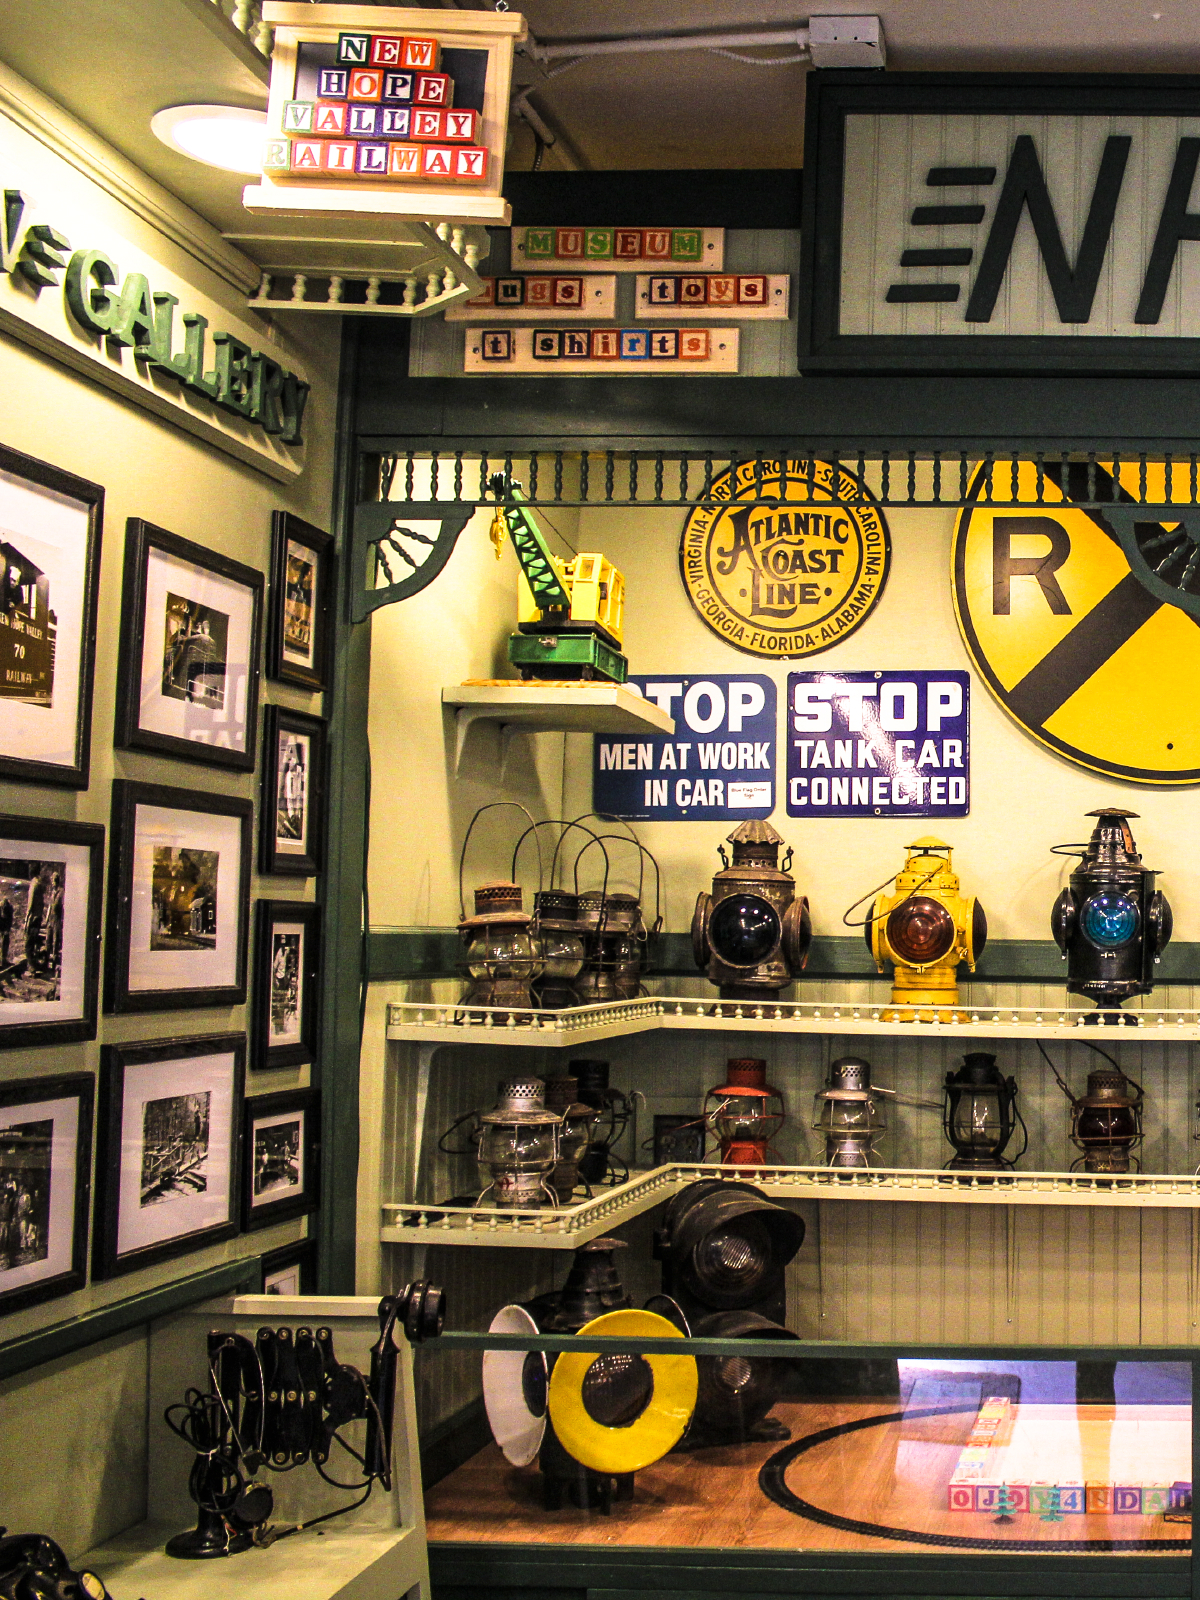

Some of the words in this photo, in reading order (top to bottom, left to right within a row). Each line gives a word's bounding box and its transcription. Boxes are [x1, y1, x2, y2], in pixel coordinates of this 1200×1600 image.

[341, 37, 433, 66] NEW
[323, 71, 445, 101] HOPE
[286, 105, 471, 137] VALLEY
[264, 143, 482, 175] RAILWAY
[529, 231, 700, 257] MUSEUM
[477, 281, 576, 302] ugs
[657, 278, 759, 301] toys
[65, 249, 310, 446] GALLERY
[540, 332, 702, 356] shirts
[687, 518, 710, 585] VIRGINIA
[716, 500, 850, 577] ATLANTIC
[758, 537, 845, 581] COAST
[993, 516, 1073, 615] R
[747, 567, 823, 619] LINE
[695, 588, 744, 642] GEORGIA
[820, 582, 876, 642] ALABAMA
[14, 643, 26, 660] 70
[749, 631, 816, 652] FLORIDA
[628, 681, 767, 734] TOP
[793, 681, 963, 733] STOP
[599, 743, 653, 770] MEN
[660, 742, 692, 770] AT
[697, 741, 771, 770] WORK
[793, 740, 879, 769] TANK
[895, 739, 965, 769] CAR
[644, 779, 668, 807] IN
[675, 778, 725, 807] CAR
[789, 776, 966, 807] CONNECTED
